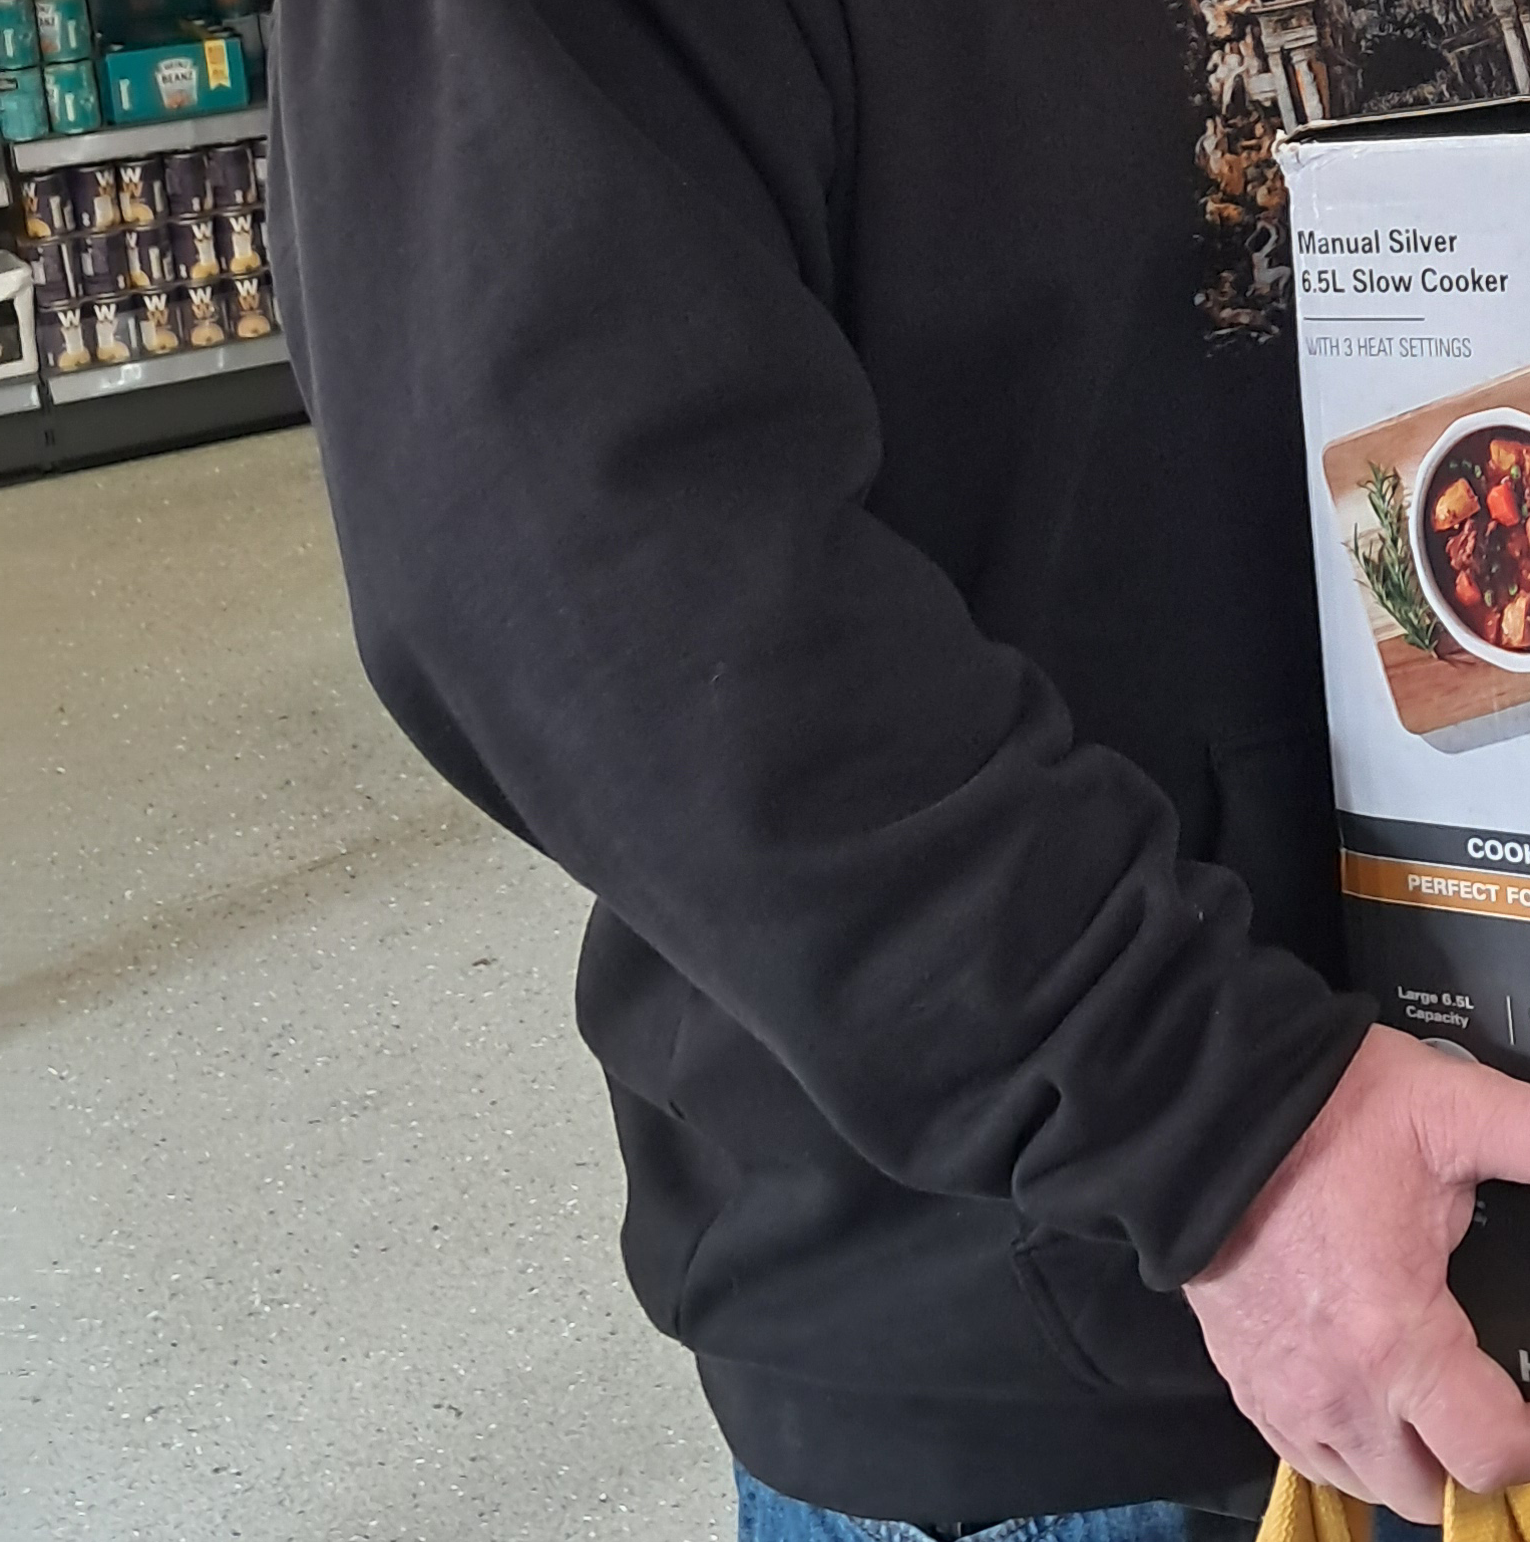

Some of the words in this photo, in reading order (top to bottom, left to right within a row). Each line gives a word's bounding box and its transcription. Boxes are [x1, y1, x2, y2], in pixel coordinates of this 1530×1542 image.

[1298, 229, 1380, 254] Manual
[1389, 228, 1457, 254] Silver
[1302, 269, 1345, 294] 6.5L
[1353, 268, 1412, 293] Slow
[1421, 267, 1509, 293] Cooker
[1305, 337, 1340, 356] WITH
[1343, 337, 1351, 356] 3
[1357, 337, 1395, 357] HEAT
[1400, 337, 1472, 358] SETTINGS
[1408, 874, 1499, 904] PERFECT
[1398, 986, 1439, 1006] Large
[1442, 993, 1474, 1010] 6.5L
[1405, 1005, 1469, 1029] Capacity
